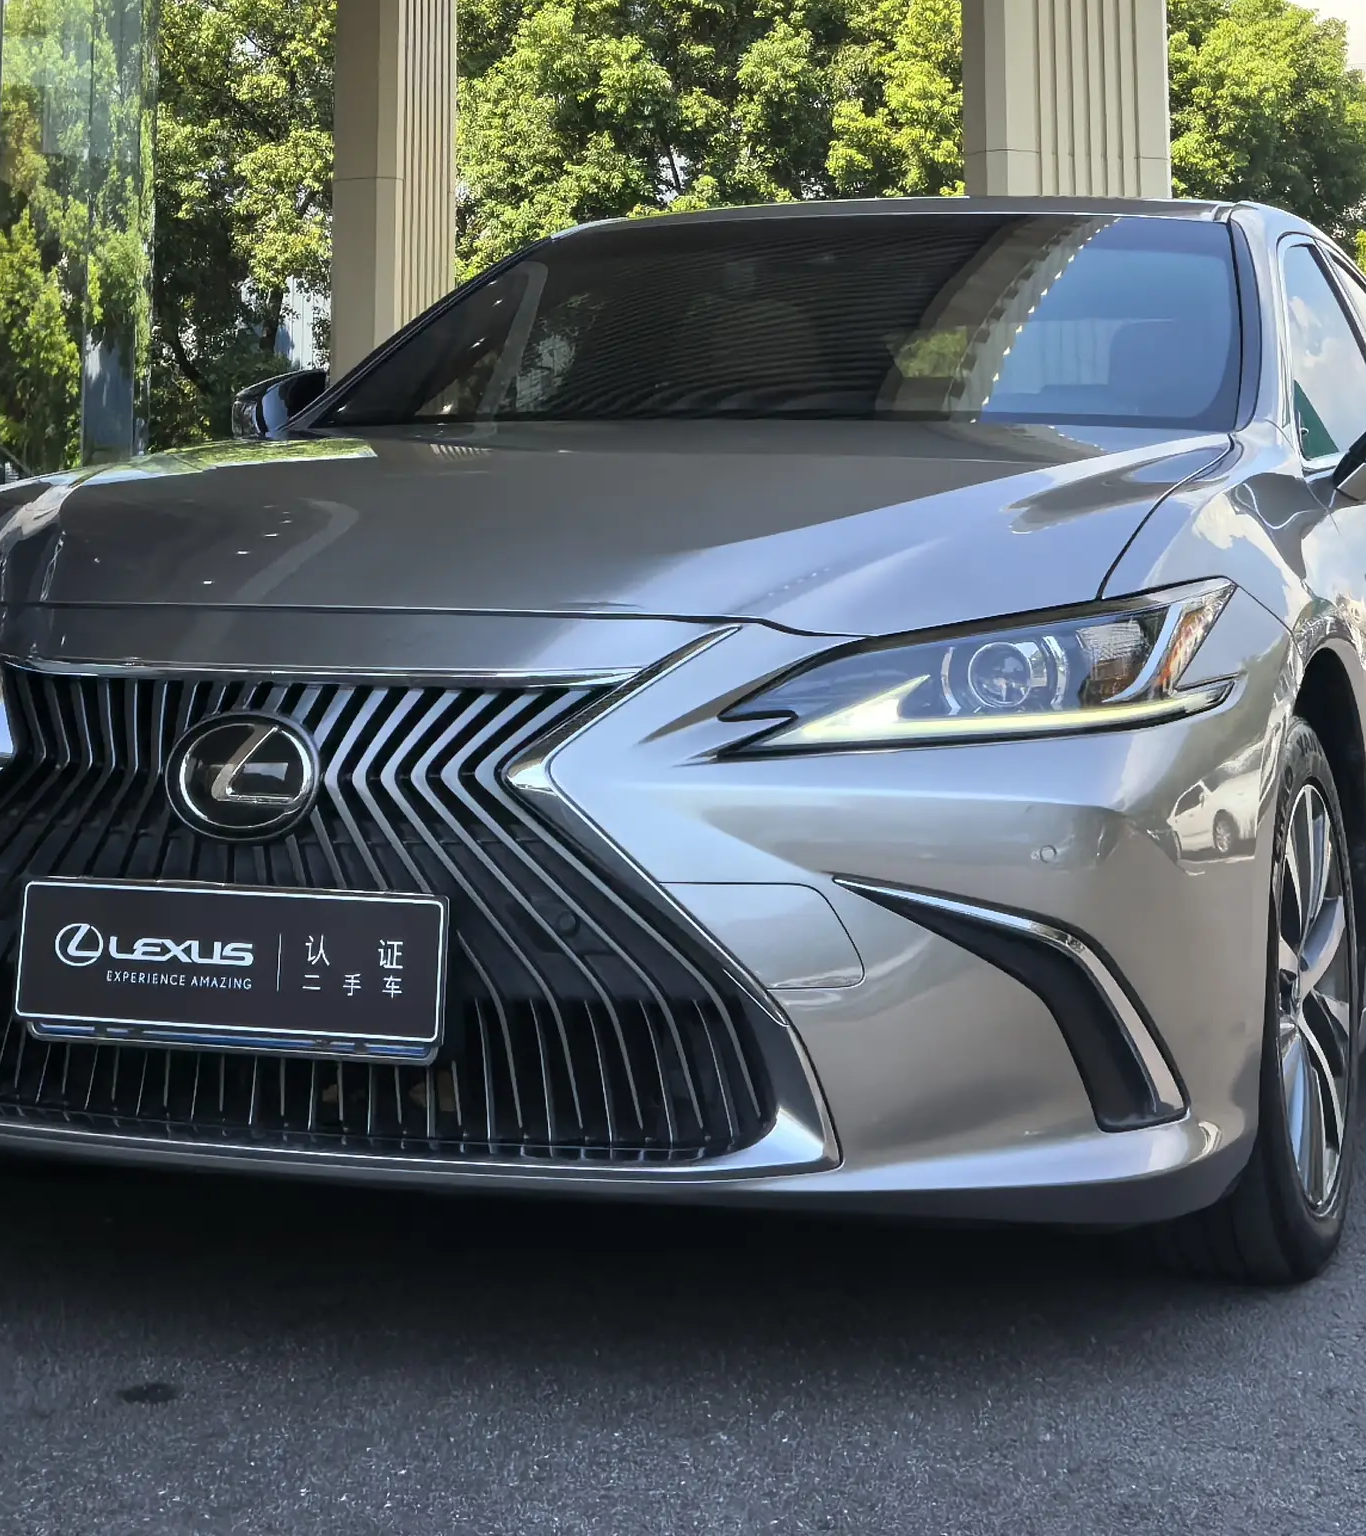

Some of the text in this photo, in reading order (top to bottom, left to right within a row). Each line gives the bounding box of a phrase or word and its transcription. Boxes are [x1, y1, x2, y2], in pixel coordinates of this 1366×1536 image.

[109, 936, 254, 966] LEXUS
[106, 970, 252, 990] EXPERIENCE AMAZING
